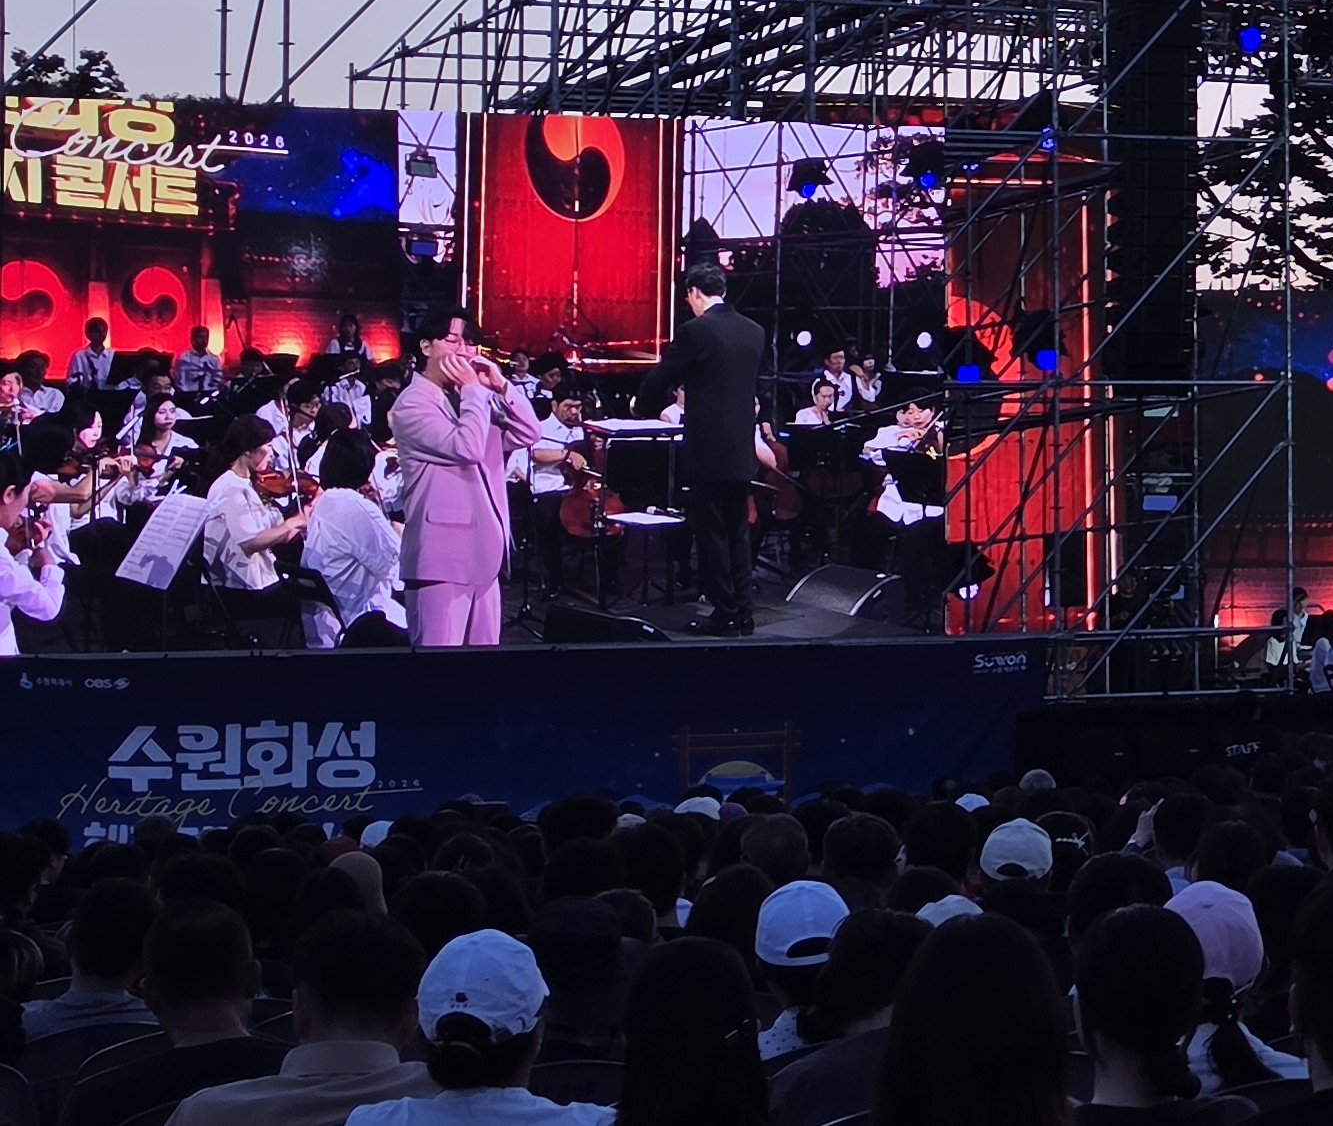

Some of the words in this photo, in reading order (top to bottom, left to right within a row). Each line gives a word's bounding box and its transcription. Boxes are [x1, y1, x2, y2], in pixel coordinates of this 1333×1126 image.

[52, 154, 199, 216] 콘서트
[84, 678, 113, 689] OBS
[107, 720, 376, 792] 수원화성
[56, 777, 216, 825] Heritage
[228, 776, 375, 819] Concert
